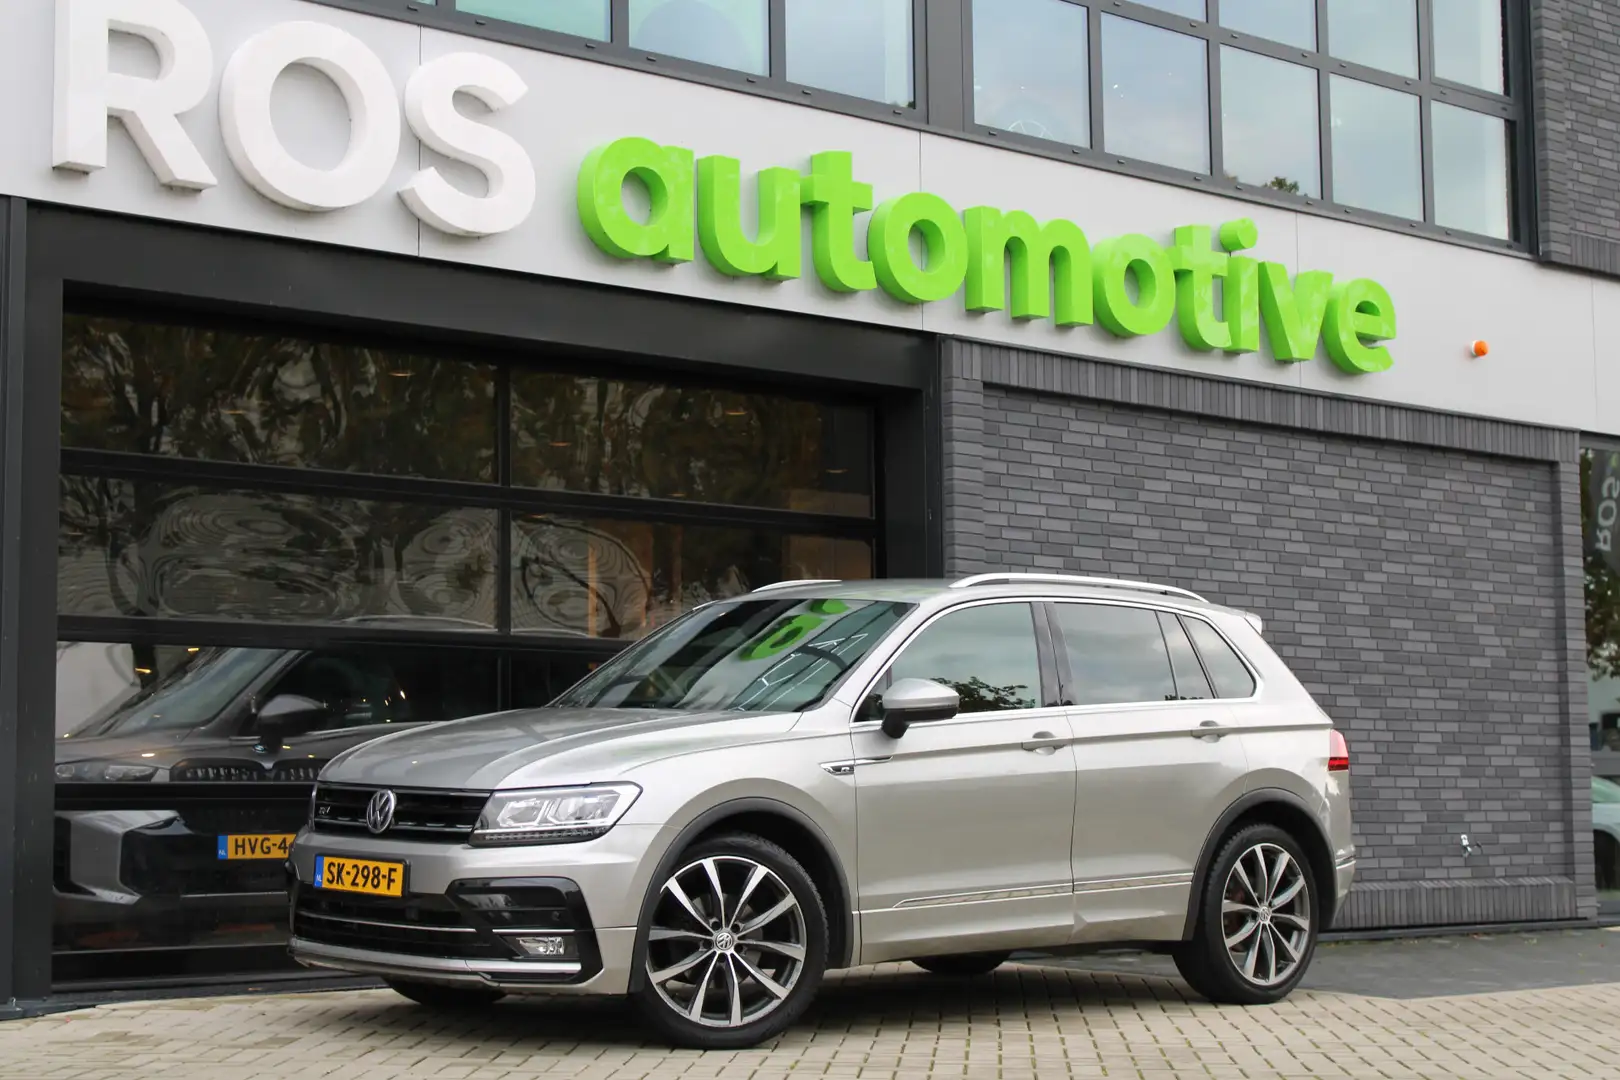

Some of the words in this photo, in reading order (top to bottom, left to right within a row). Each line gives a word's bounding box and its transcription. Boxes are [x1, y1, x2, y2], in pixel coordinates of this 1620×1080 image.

[53, 0, 536, 237] ROS
[578, 136, 1396, 375] automotive
[326, 861, 398, 890] SK-298-F
